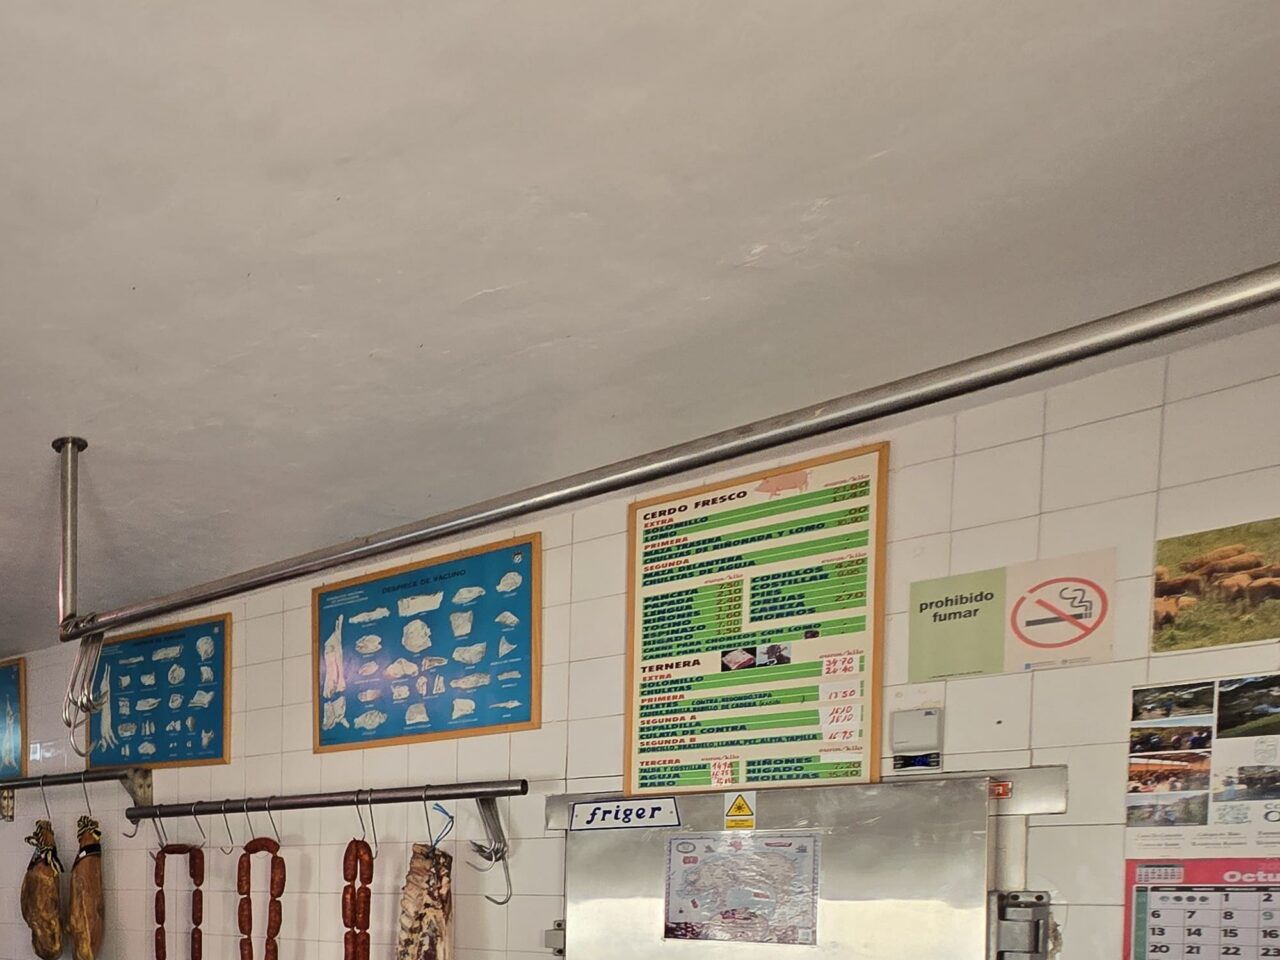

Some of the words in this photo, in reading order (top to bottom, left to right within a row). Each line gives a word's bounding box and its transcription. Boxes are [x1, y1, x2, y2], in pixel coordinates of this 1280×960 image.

[643, 505, 688, 520] CERDO
[694, 491, 747, 509] FRESCO
[643, 516, 708, 535] SOLOMILLO
[644, 517, 674, 528] EXTRA
[642, 550, 692, 564] CHULETAS
[712, 533, 773, 550] RIÑONADA
[789, 523, 826, 535] LOMO
[644, 531, 677, 543] LOMO
[644, 537, 689, 550] PRIMERA
[643, 547, 673, 557] MAZA
[676, 536, 722, 550] TRASERA
[643, 559, 689, 572] SEGUNDA
[643, 569, 673, 579] MAZA
[678, 555, 743, 572] DELANTERA
[642, 572, 695, 587] CHULETAS
[699, 568, 713, 576] DE
[718, 560, 756, 573] AGUJA
[751, 566, 824, 583] CODILLOS
[751, 573, 829, 591] COSTILLAR
[644, 588, 698, 603] PANCETA
[750, 593, 805, 606] OREJAS
[751, 588, 782, 599] PIES
[644, 597, 695, 610] PAPADA
[750, 601, 805, 614] CABEZA
[919, 590, 994, 613] prohibido
[644, 605, 693, 618] LENGUA
[749, 607, 816, 623] MORROS
[932, 607, 980, 623] fumar
[643, 620, 692, 632] TOCINO
[643, 624, 706, 639] ESPINAZO
[642, 645, 673, 654] CARNE
[676, 641, 702, 649] PARA
[705, 632, 756, 644] CHORIZOS
[761, 629, 783, 637] CON
[788, 623, 821, 632] LOMO
[643, 634, 693, 647] HIGADO
[642, 652, 673, 660] CARNE
[676, 648, 702, 656] PARA
[705, 640, 756, 652] CHORIZOS
[641, 659, 701, 673] TERNERA
[641, 676, 705, 689] SOLOMILLO
[643, 673, 672, 682] EXTRA
[640, 685, 692, 696] CHULETAS
[641, 694, 685, 704] PRIMERA
[640, 701, 679, 711] FILETES
[640, 716, 686, 726] SEGUNDA
[640, 721, 702, 732] ESPALDILLA
[640, 730, 677, 740] CULATA
[701, 724, 747, 734] CONTRA
[640, 738, 686, 747] SEGUNDA
[640, 758, 681, 767] TERCERA
[746, 757, 813, 767] RIÑONES
[746, 765, 804, 774] HIGADO
[640, 773, 681, 781] AGUJA
[746, 773, 820, 783] MOLLEJAS
[640, 780, 676, 788] RABO
[585, 804, 662, 825] friger
[1223, 893, 1230, 902] 1
[1262, 893, 1273, 902] 2
[1151, 910, 1161, 918] 6
[1186, 910, 1196, 919] 7
[1223, 911, 1234, 920] 8
[1262, 912, 1274, 920] 9
[1150, 927, 1165, 936] 13
[1186, 928, 1202, 937] 14
[1222, 929, 1238, 938] 15
[1262, 930, 1279, 939] 16
[1149, 945, 1170, 953] 20
[1185, 946, 1200, 954] 21
[1222, 947, 1241, 956] 22
[1261, 948, 1280, 956] 23
